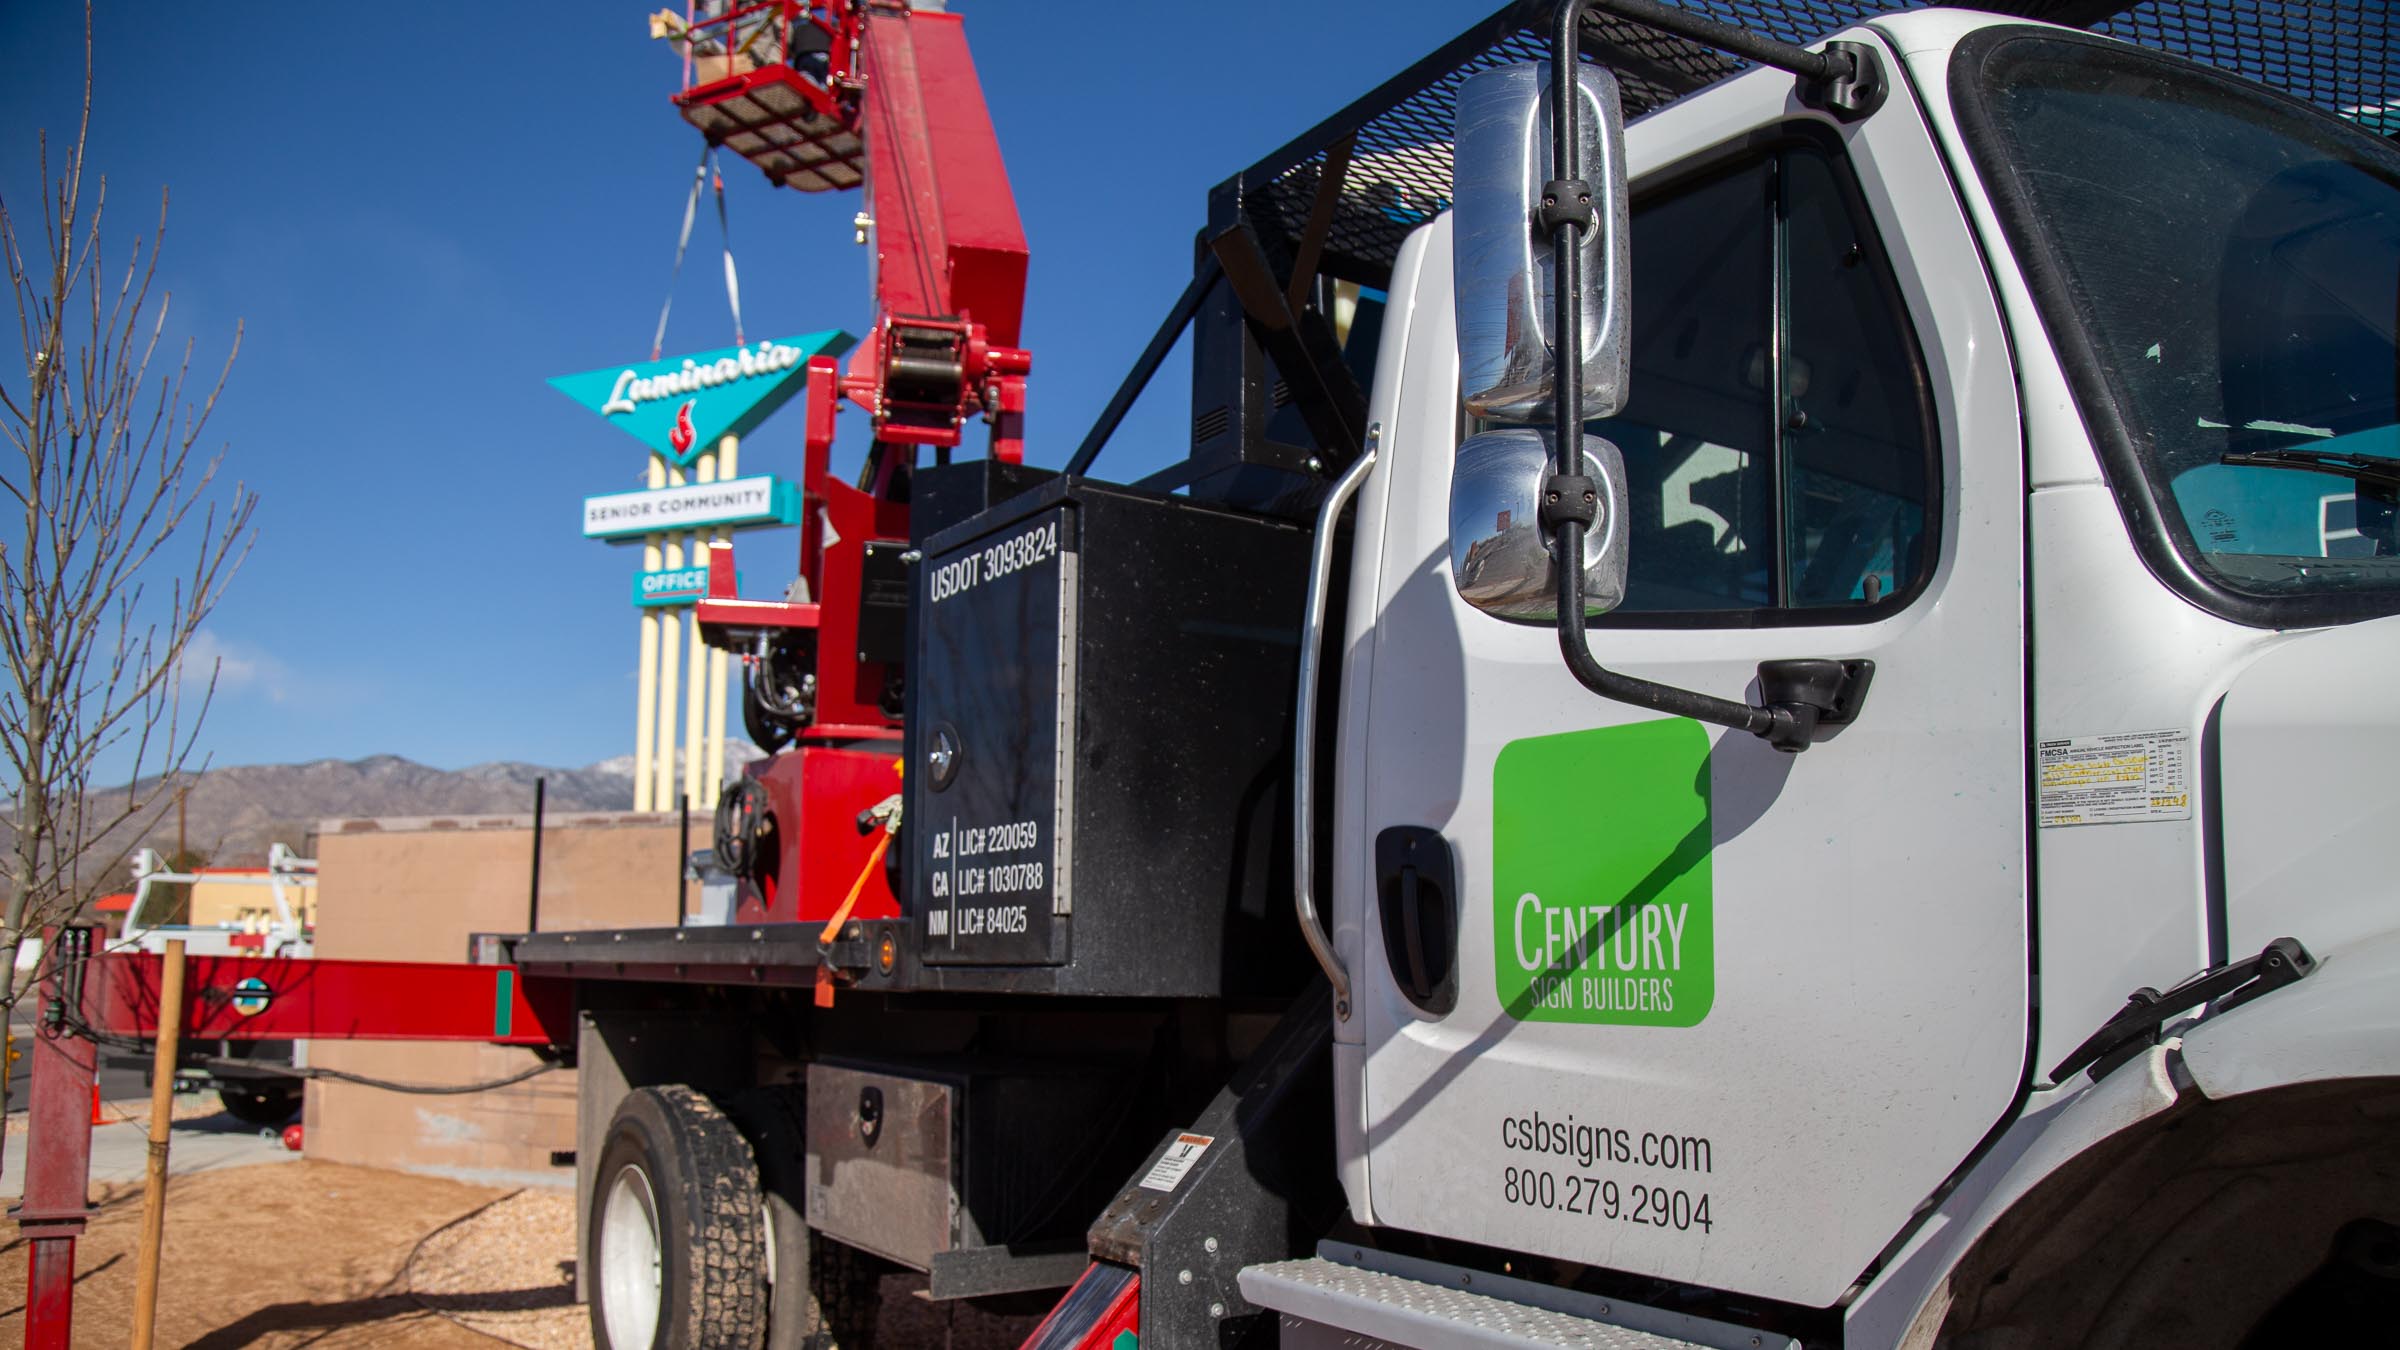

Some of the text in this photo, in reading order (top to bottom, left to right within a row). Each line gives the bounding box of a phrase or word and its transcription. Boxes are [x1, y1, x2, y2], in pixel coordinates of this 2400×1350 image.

[602, 341, 802, 415] Luminaria
[590, 489, 766, 521] SENIOR COMMUNITY
[931, 521, 1057, 602] USDOT 3093824
[642, 571, 706, 593] OFFICE
[2040, 748, 2068, 758] FMCSA
[933, 821, 1037, 858] AZ LIC# 220059
[932, 861, 1043, 897] CA LIC# 1030788
[928, 906, 1027, 936] NM LIC# 84025
[1514, 892, 1689, 971] CENTURY
[1530, 975, 1673, 1012] SIGN BUILDERS
[1502, 1111, 1713, 1173] csbsigns.com
[1504, 1166, 1714, 1235] 800.279.2904
